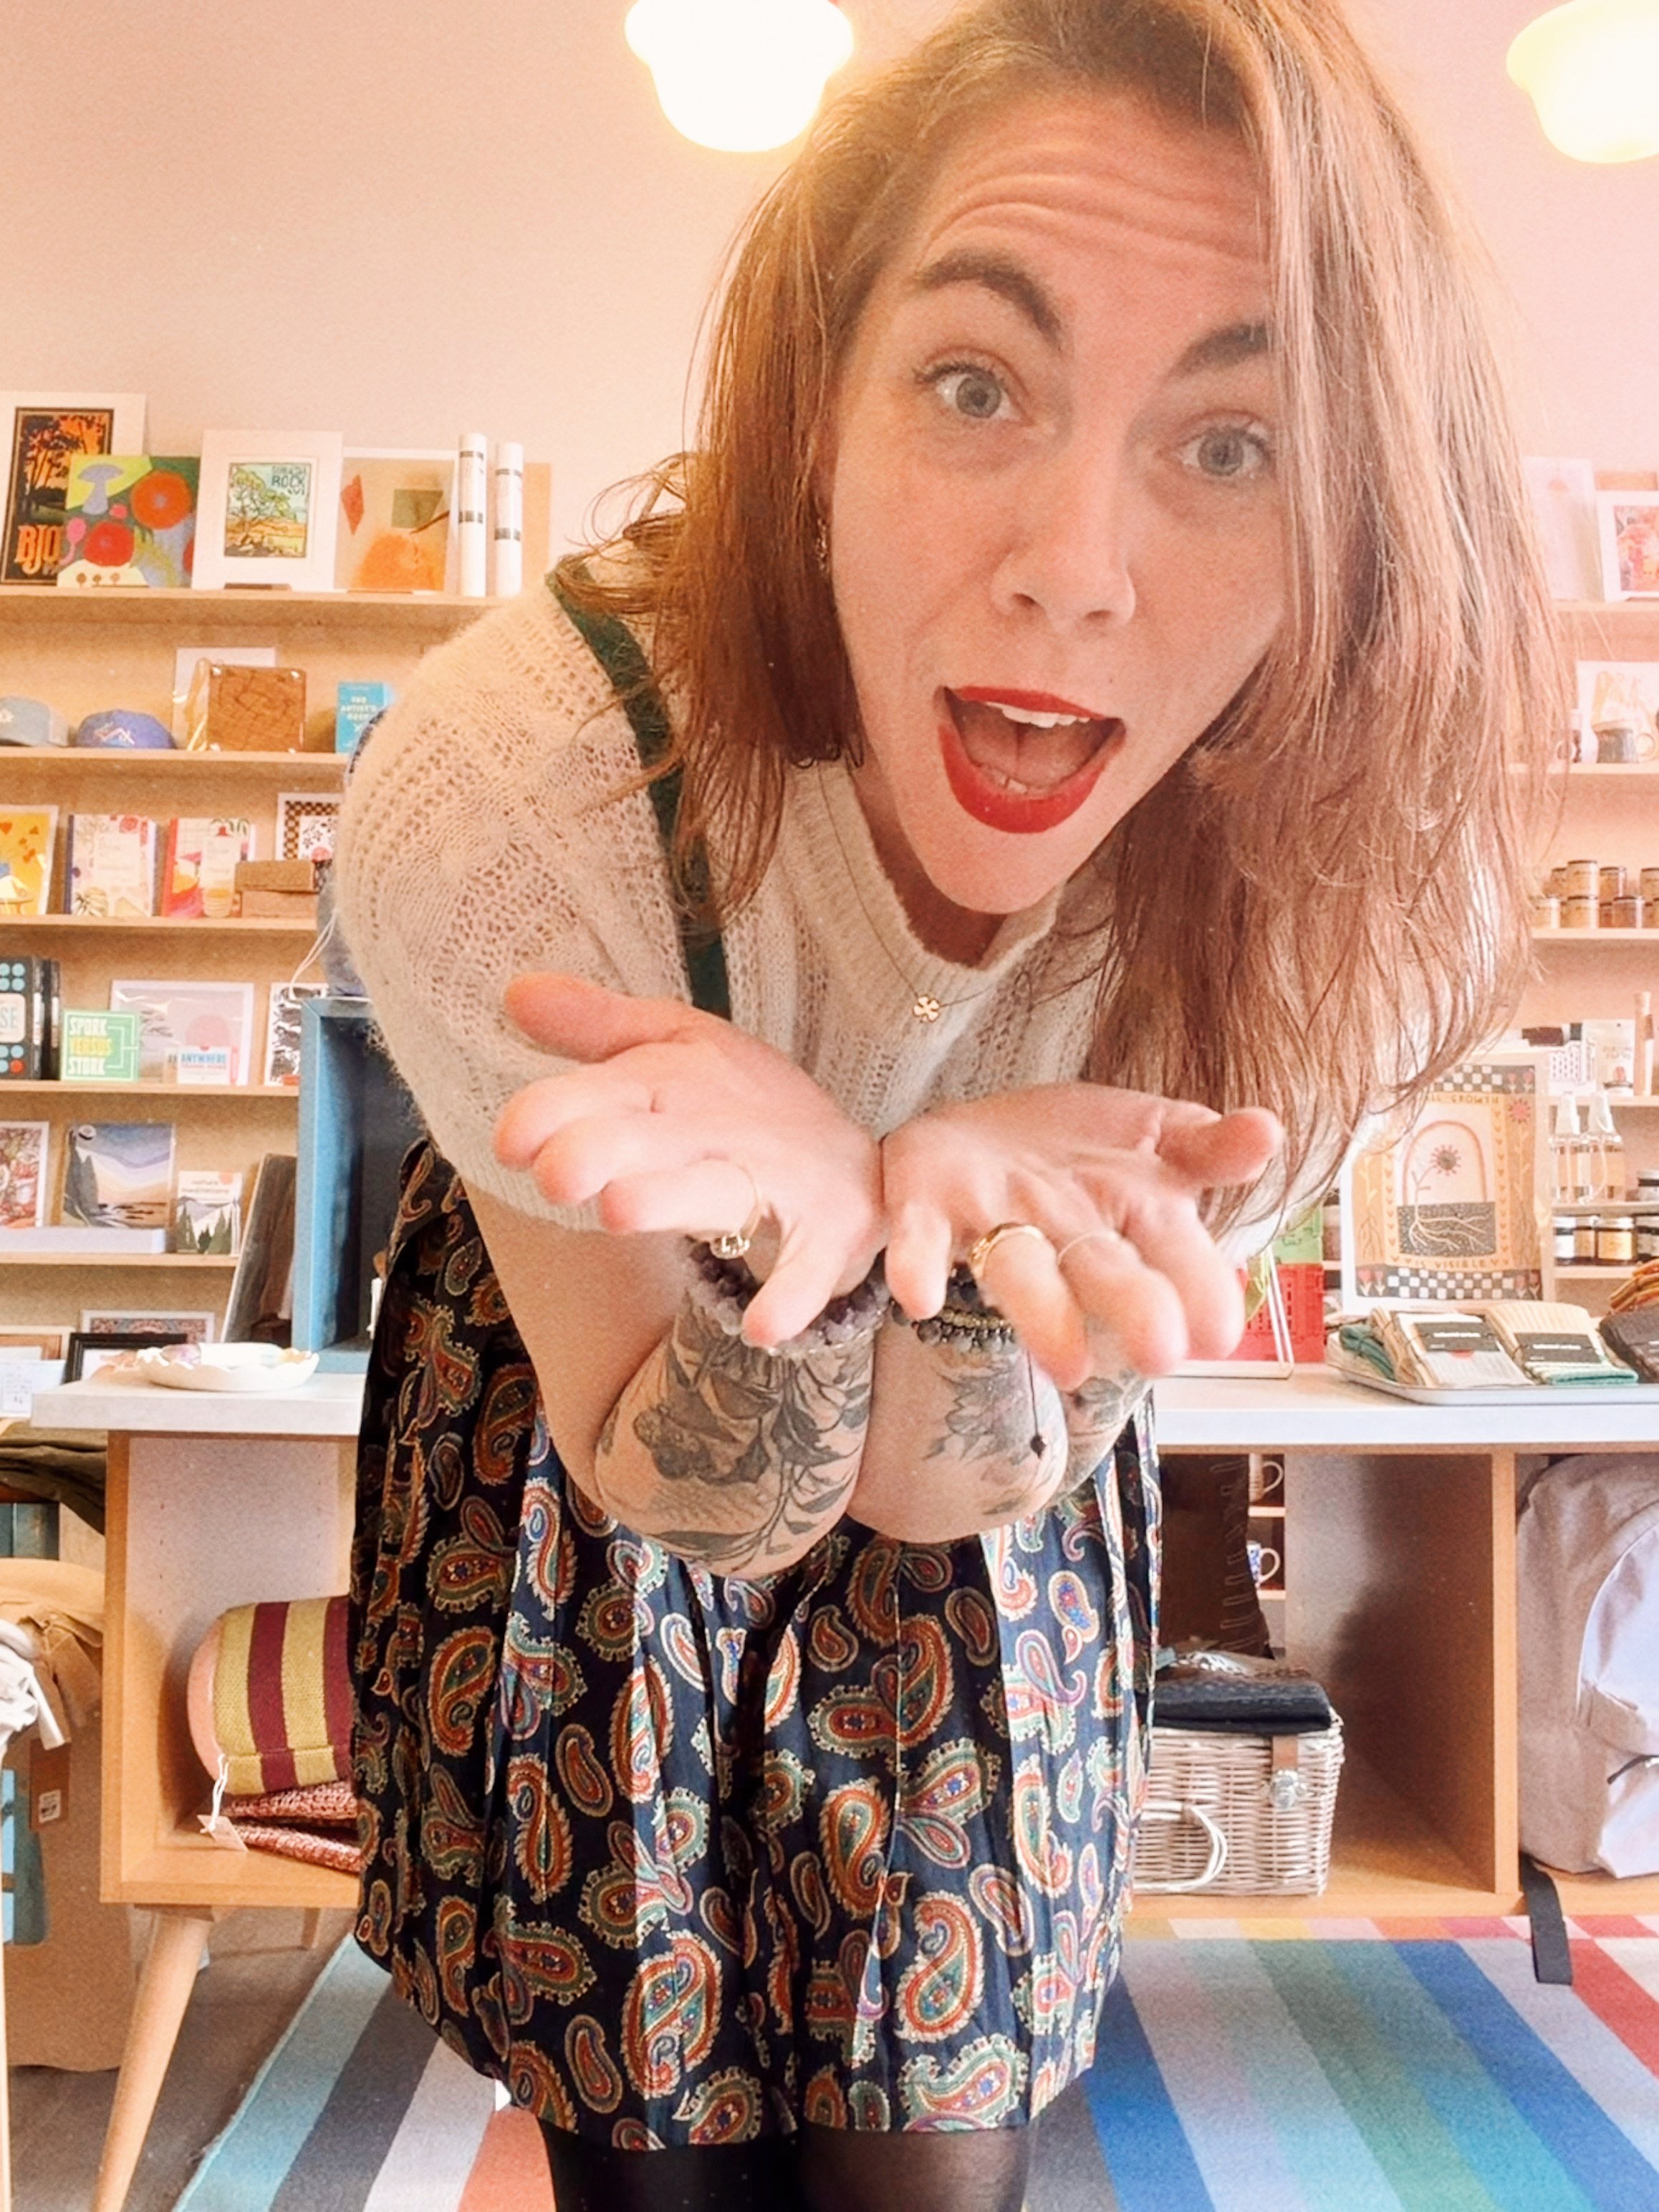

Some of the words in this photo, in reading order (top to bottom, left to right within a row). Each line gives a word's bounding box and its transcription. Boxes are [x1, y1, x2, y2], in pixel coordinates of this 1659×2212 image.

[69, 1017, 107, 1036] SPORK
[70, 1037, 112, 1056] VERSUS
[68, 1057, 105, 1075] STORK
[181, 1052, 226, 1063] ANYWHERE
[1434, 1260, 1486, 1269] VISIBLE
